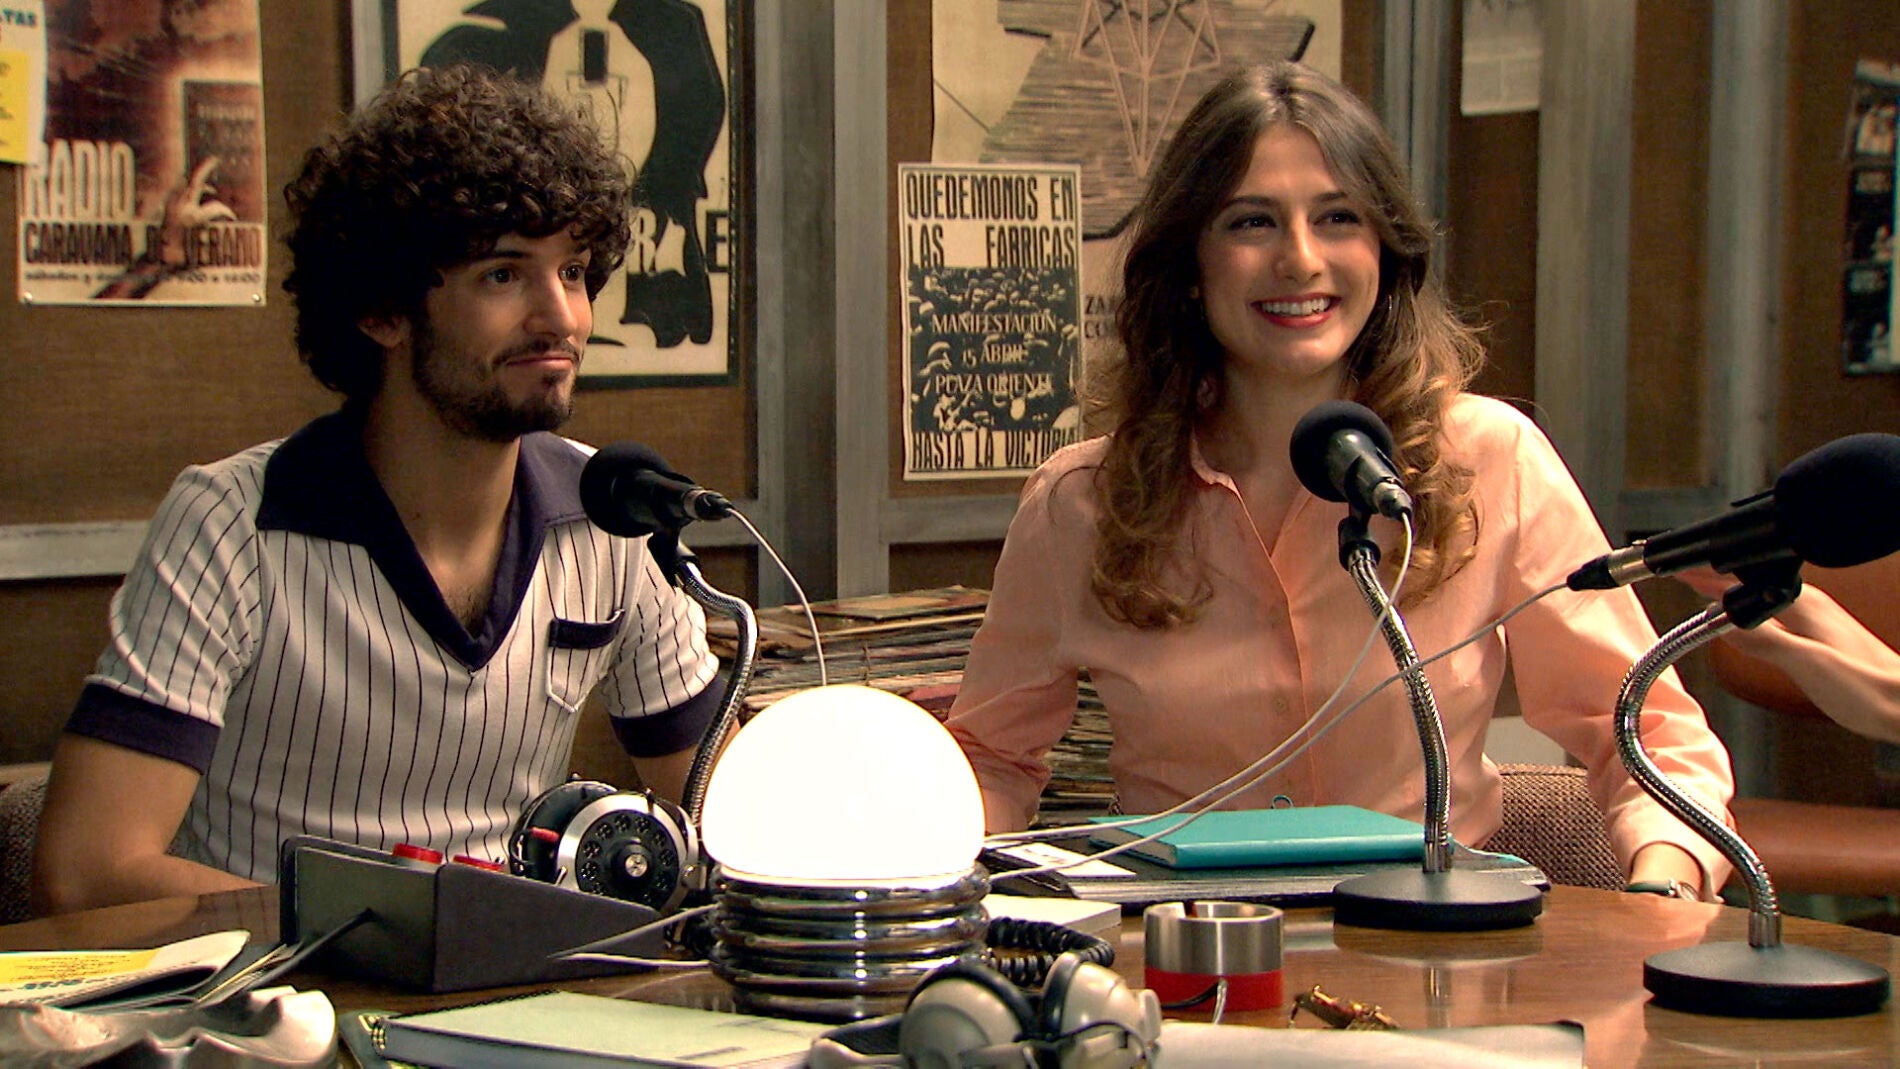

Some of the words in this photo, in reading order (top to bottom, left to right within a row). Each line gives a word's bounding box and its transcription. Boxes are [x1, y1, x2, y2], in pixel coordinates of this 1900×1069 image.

[24, 137, 136, 220] RADIO
[906, 172, 1038, 222] QUEDEMONOS
[1050, 177, 1074, 222] EN
[907, 223, 945, 268] LAS
[985, 224, 1075, 270] FABRICAS
[912, 430, 964, 470] HASTA
[975, 428, 995, 468] LA
